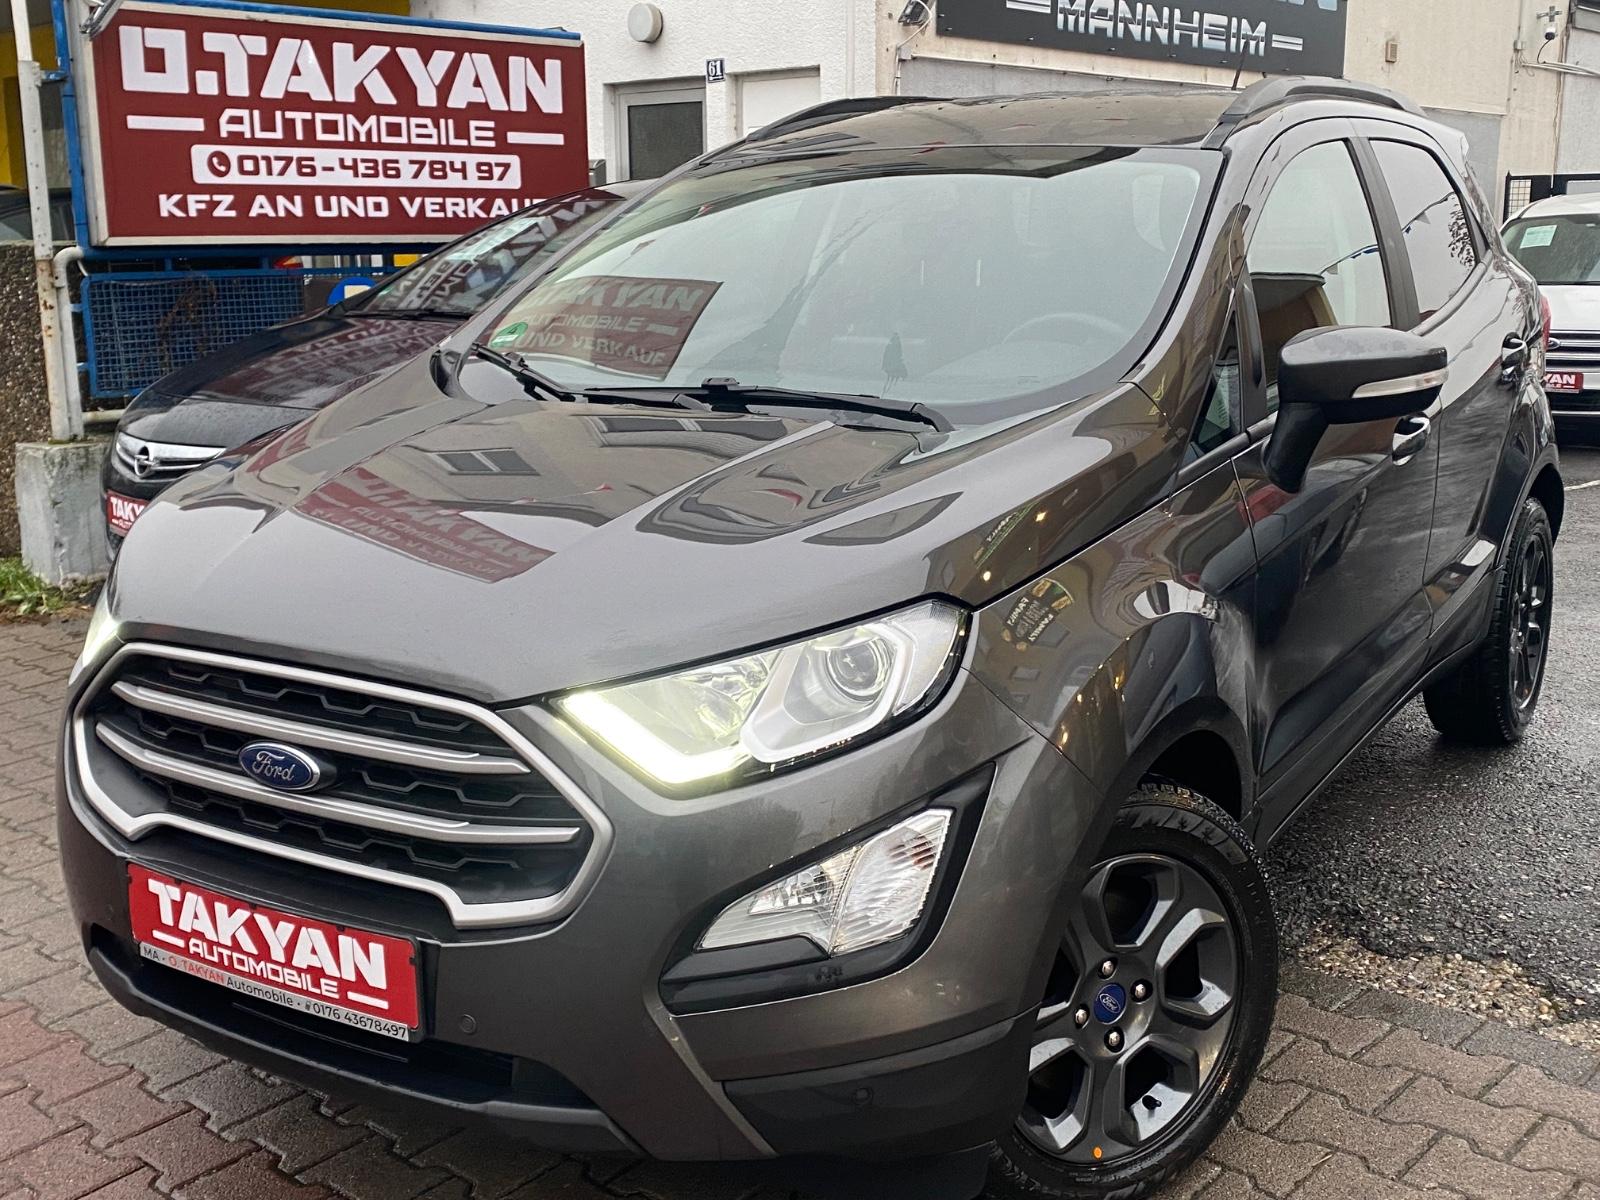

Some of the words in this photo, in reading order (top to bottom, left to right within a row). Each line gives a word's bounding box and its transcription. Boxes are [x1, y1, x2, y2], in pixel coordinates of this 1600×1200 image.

[1057, 0, 1266, 57] MANNHEIM
[708, 60, 722, 77] 61
[219, 107, 496, 149] AUTOMOBILE
[408, 159, 468, 181] 784
[475, 161, 512, 182] 97
[158, 193, 237, 218] KFZ
[248, 194, 304, 218] AN
[314, 195, 389, 218] UND
[399, 196, 548, 219] VERKA
[252, 750, 297, 781] Ford
[147, 878, 387, 990] TAKYAN
[188, 937, 340, 999] AUTOMOBILE
[143, 945, 160, 961] MA
[226, 976, 294, 1007] Automobile
[312, 1002, 341, 1020] 0176
[343, 1011, 407, 1039] 43678497
